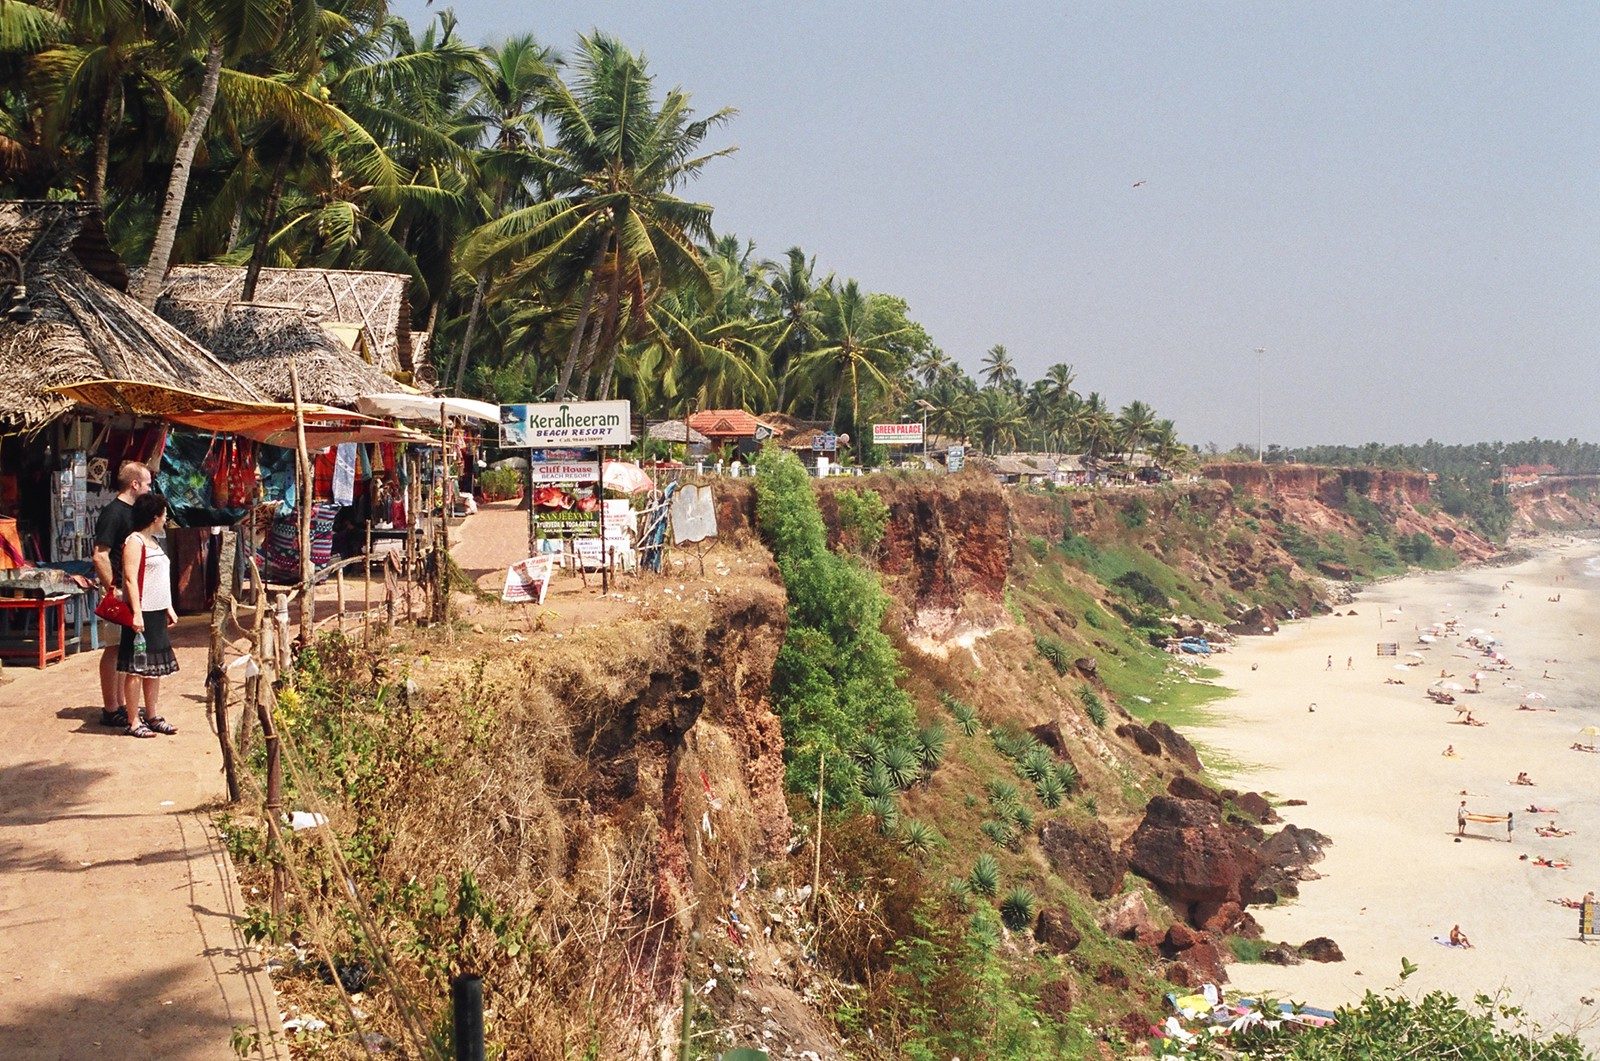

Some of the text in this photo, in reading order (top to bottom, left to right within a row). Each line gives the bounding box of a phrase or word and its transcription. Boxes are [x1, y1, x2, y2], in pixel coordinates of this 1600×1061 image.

[536, 428, 612, 437] BEACH RESORT
[874, 425, 922, 434] GREEN PALACE
[540, 512, 593, 520] SANJEEVANI
